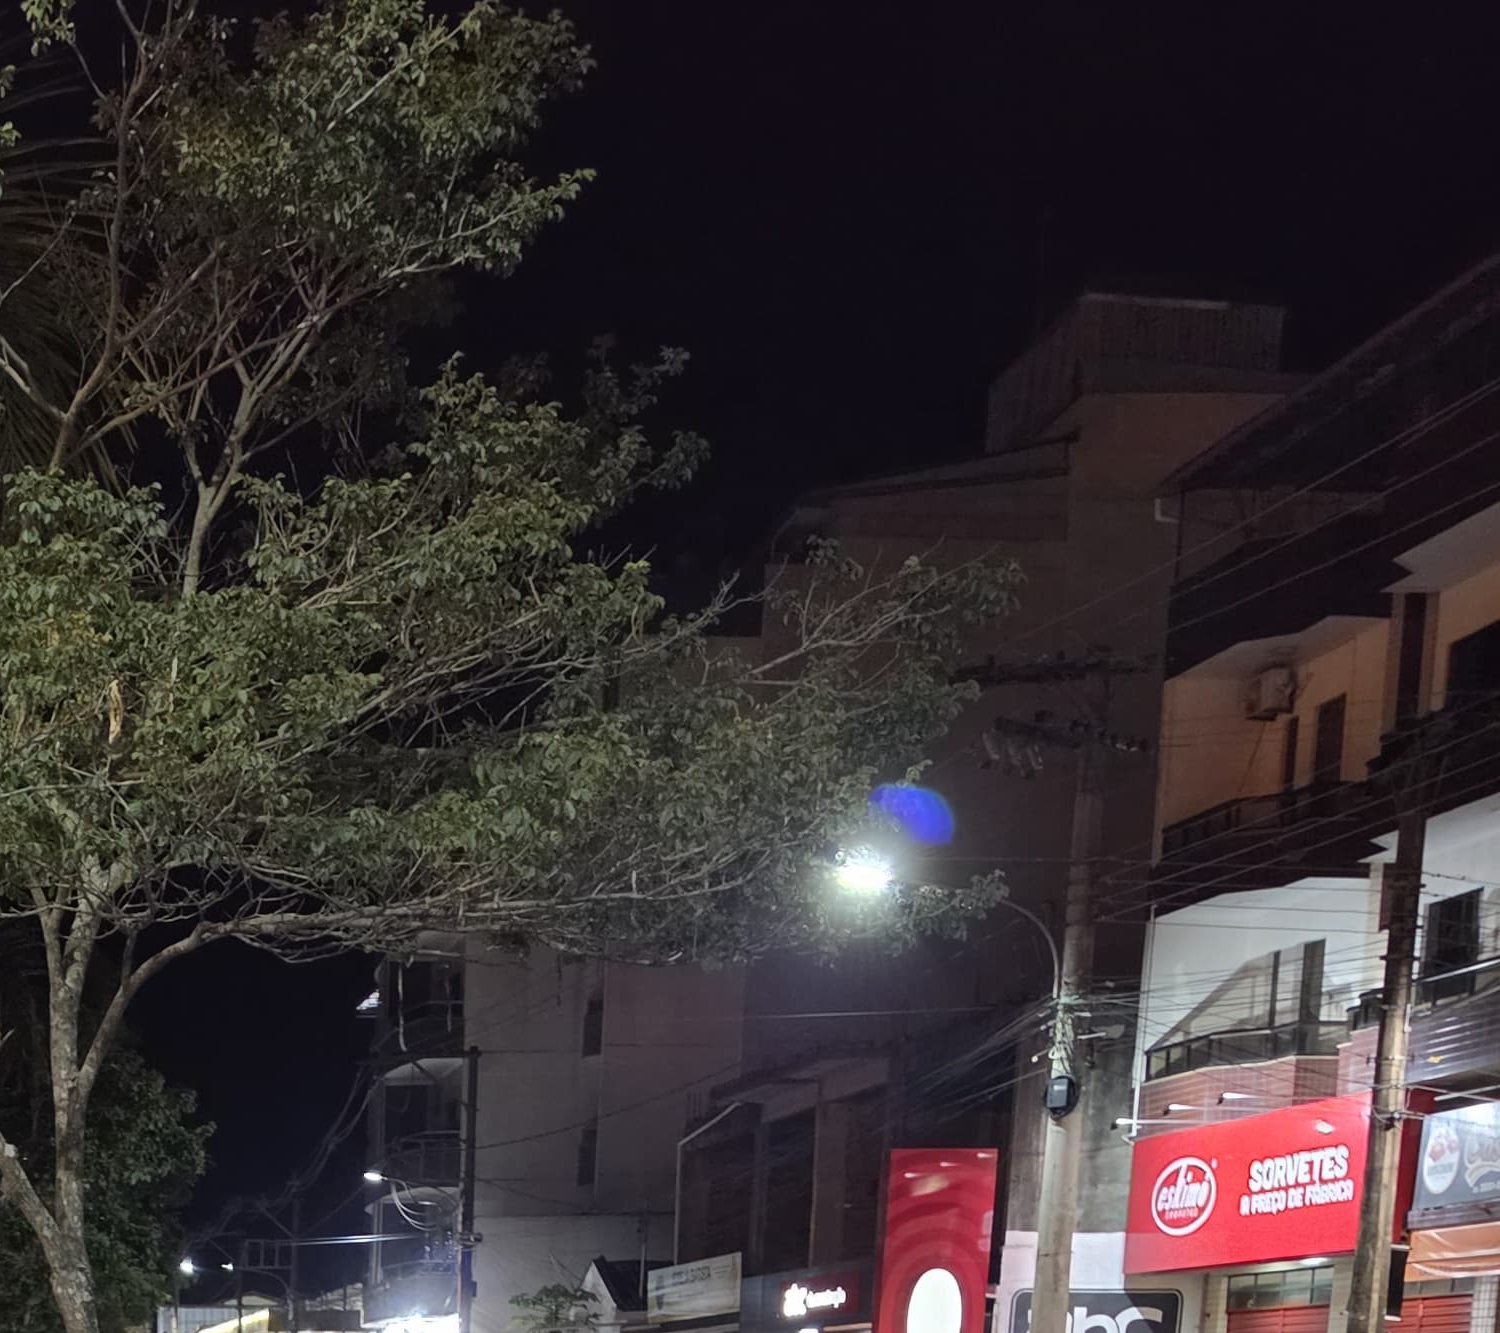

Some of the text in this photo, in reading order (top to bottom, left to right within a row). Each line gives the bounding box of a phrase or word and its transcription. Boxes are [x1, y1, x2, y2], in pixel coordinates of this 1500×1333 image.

[1248, 1146, 1349, 1191] SORVETES
[1239, 1195, 1249, 1215] A
[1250, 1190, 1287, 1216] PREÇO
[1287, 1188, 1304, 1209] DE
